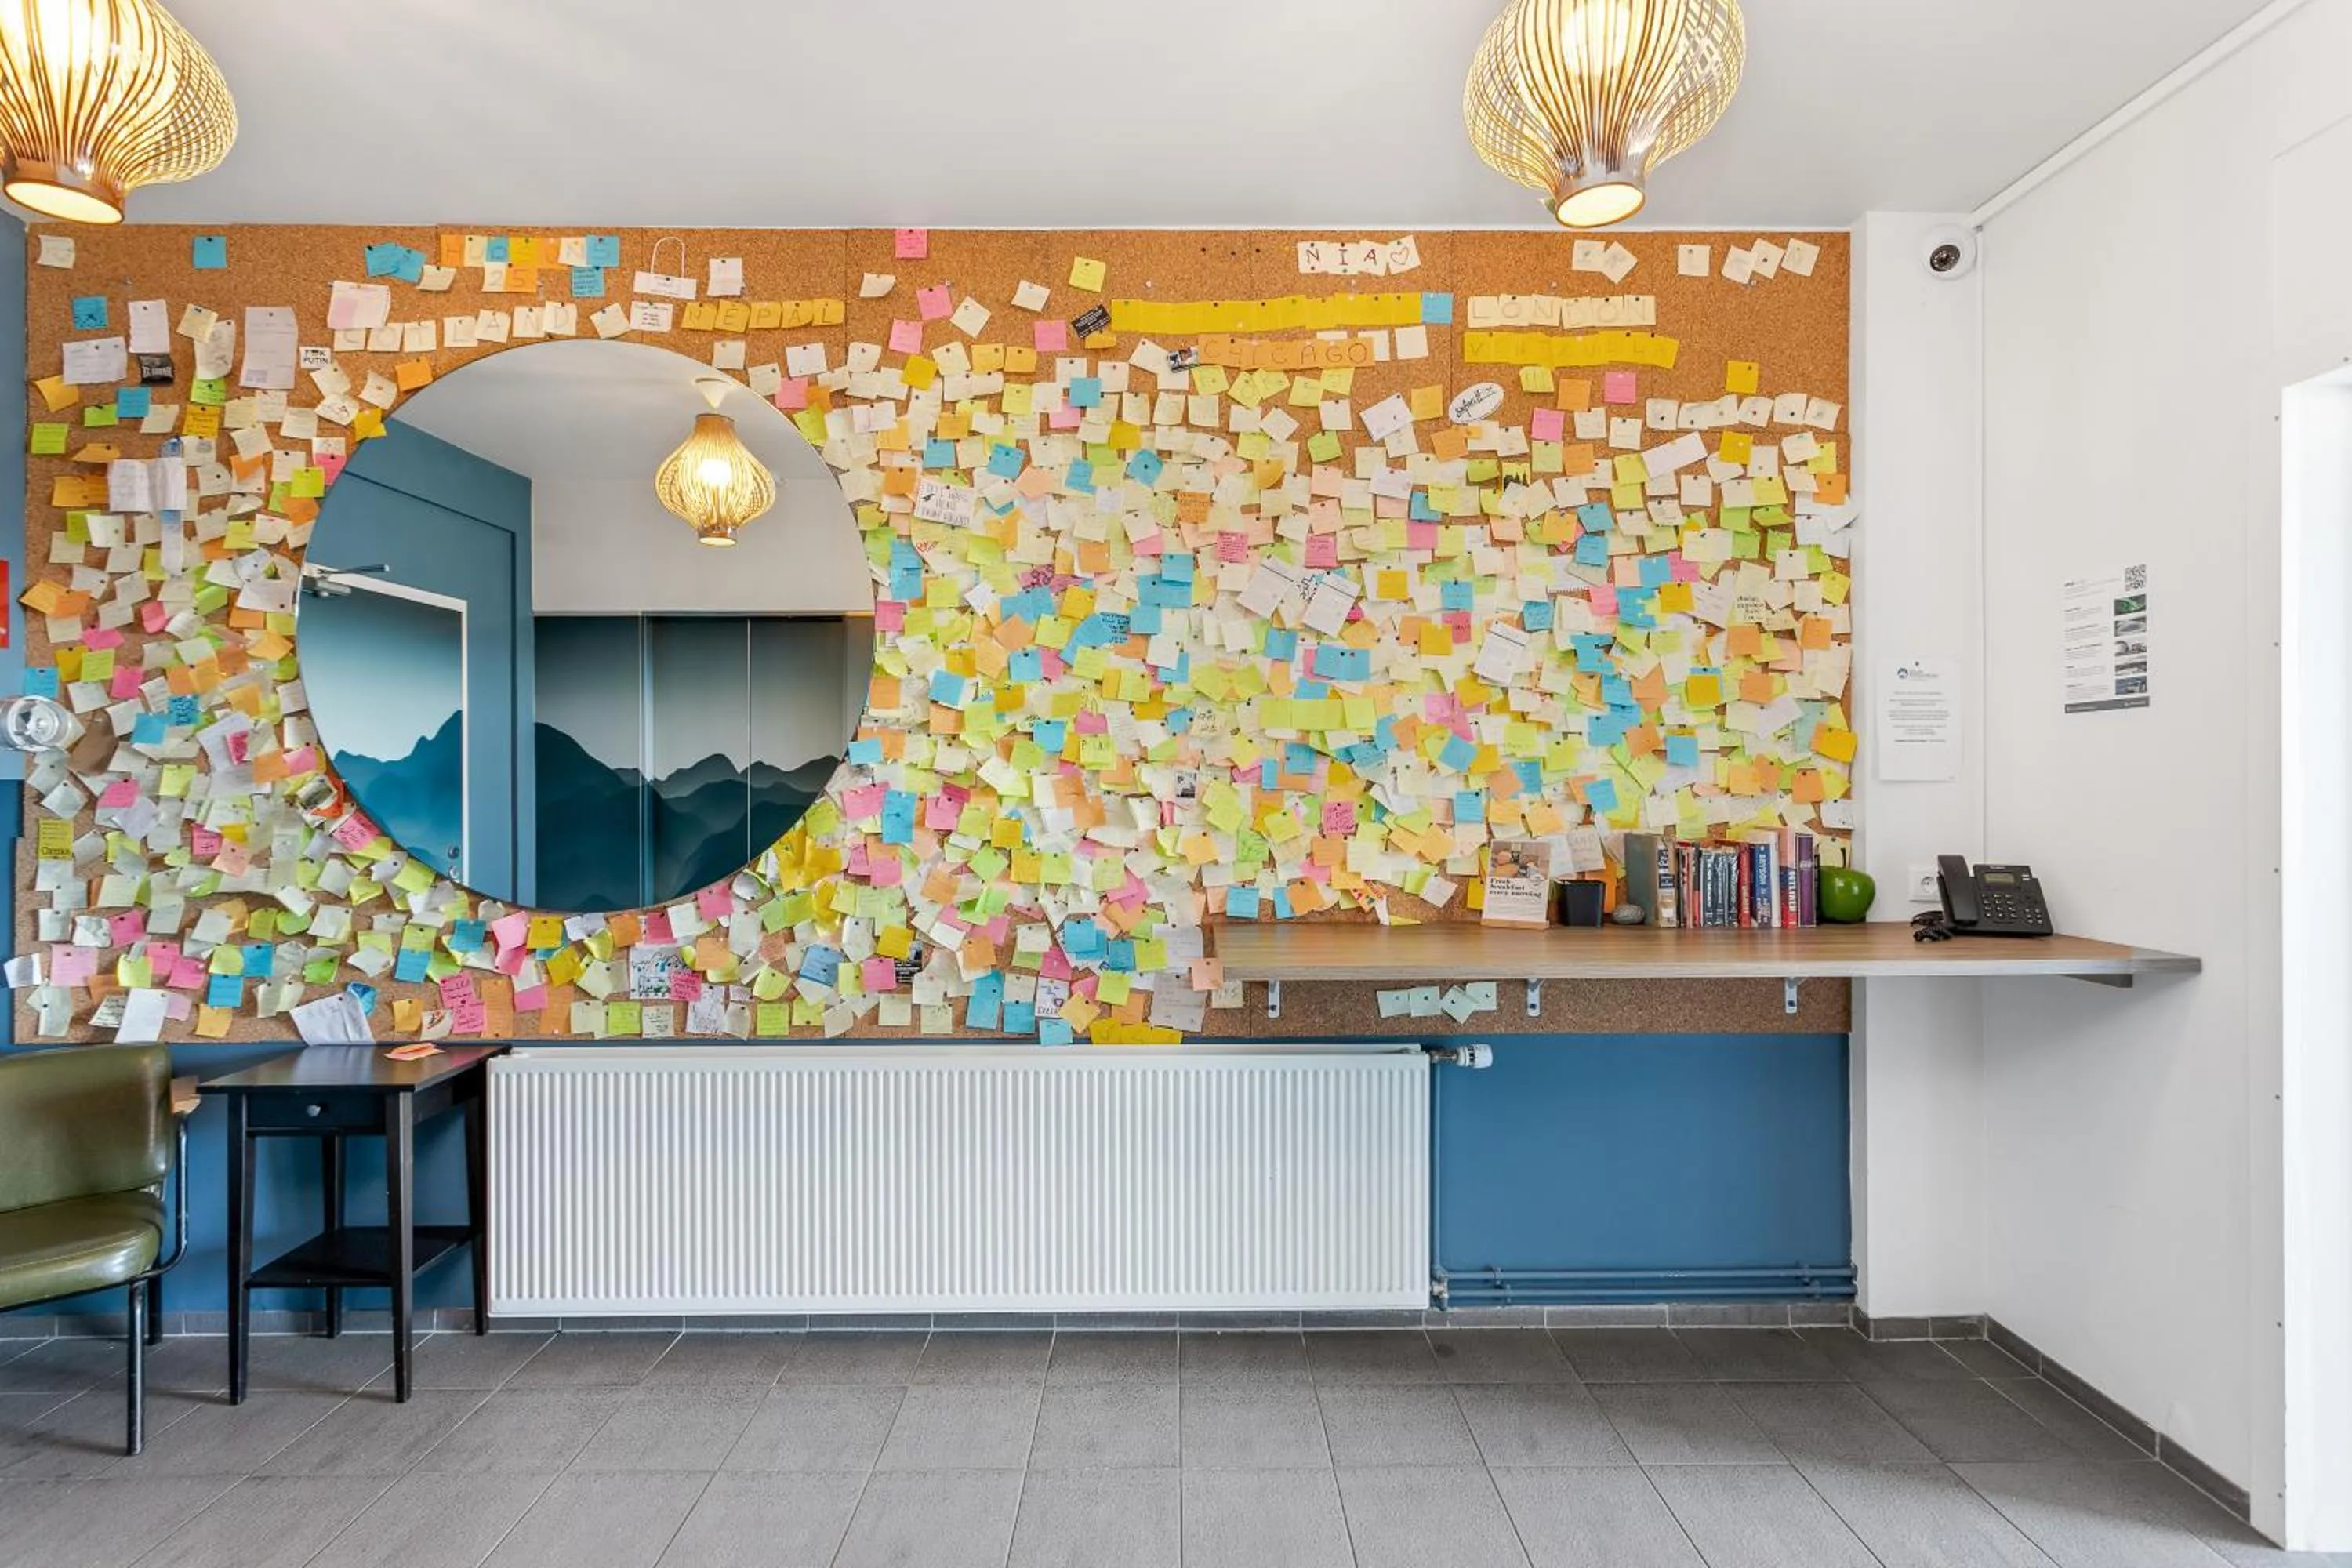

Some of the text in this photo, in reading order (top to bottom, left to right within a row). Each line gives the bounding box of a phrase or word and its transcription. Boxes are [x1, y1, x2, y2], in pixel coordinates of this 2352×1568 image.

[1305, 248, 1378, 266] NIA
[688, 307, 833, 326] NEPAL
[1472, 299, 1646, 326] LONDON
[1203, 339, 1369, 366] CHICAGO
